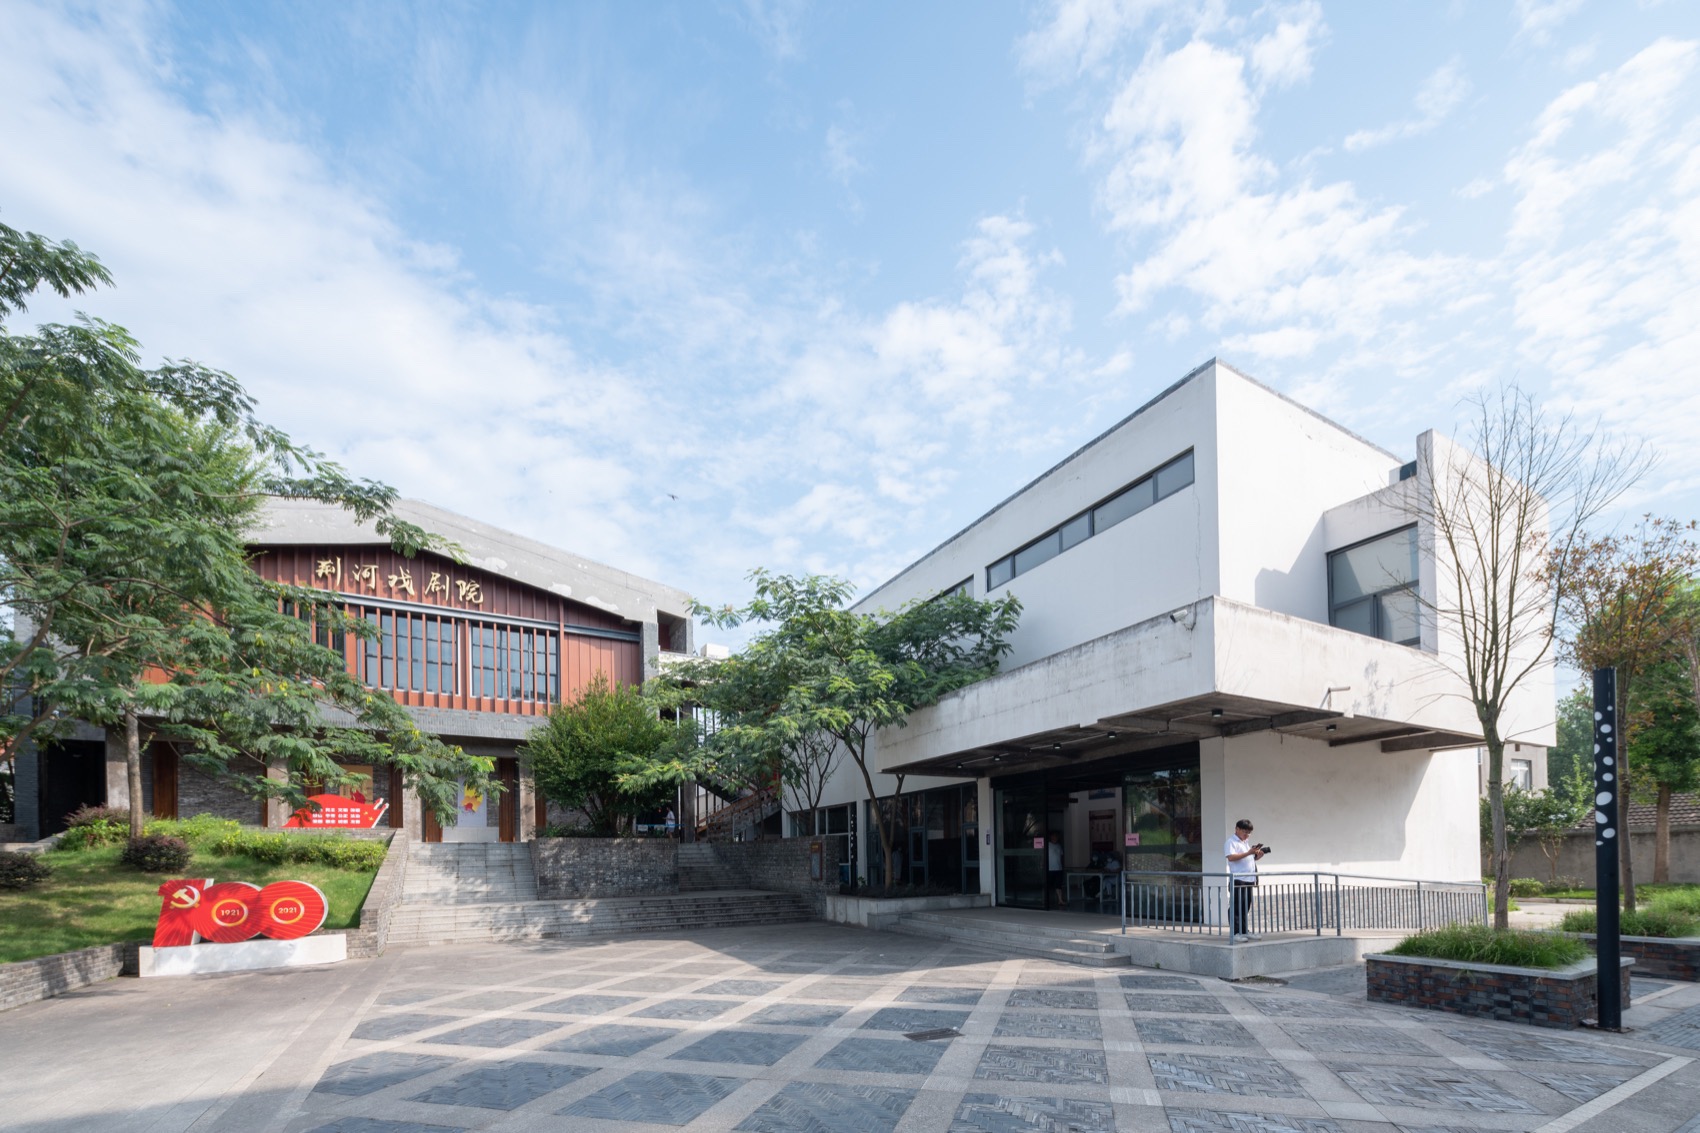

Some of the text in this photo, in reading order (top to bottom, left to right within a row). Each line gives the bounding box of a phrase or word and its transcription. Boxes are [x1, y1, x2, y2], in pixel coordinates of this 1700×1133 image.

[315, 556, 483, 604] 荆河戏剧院
